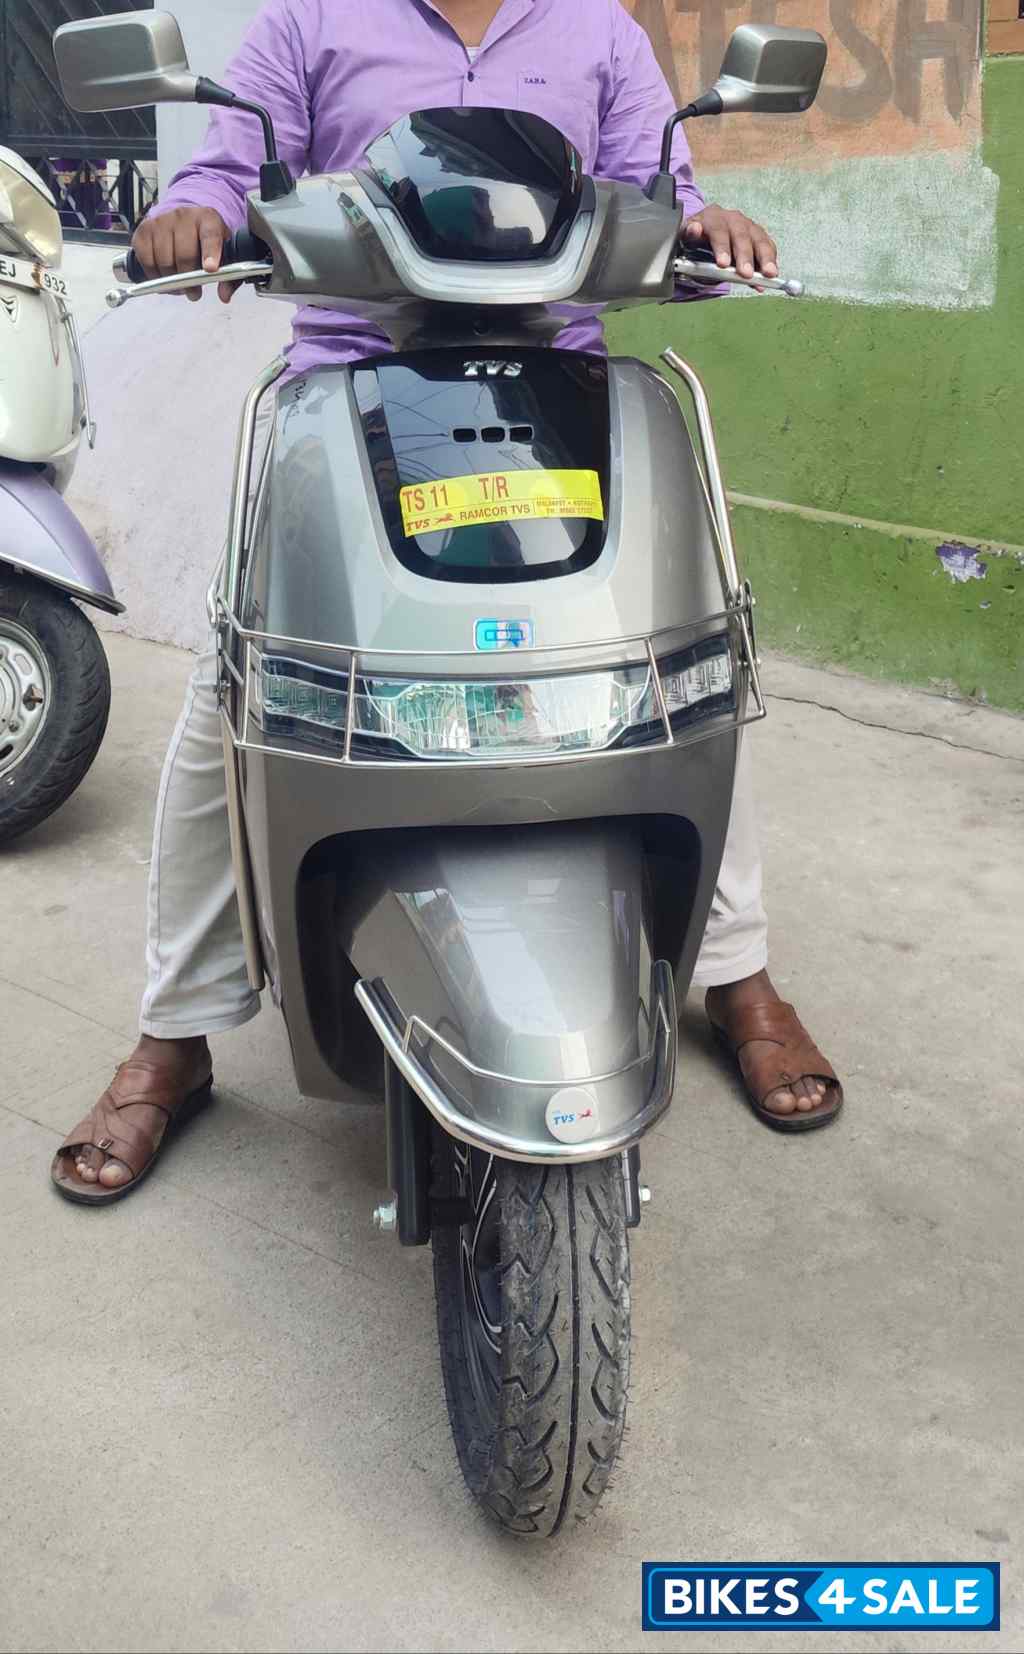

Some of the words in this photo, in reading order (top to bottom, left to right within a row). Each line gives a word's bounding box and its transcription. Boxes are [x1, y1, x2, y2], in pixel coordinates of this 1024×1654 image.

[464, 360, 523, 376] TVS
[402, 488, 425, 513] TS
[430, 484, 448, 508] 11
[478, 475, 510, 504] T/R
[406, 518, 430, 533] TVS
[460, 506, 508, 521] RAMCOR
[511, 503, 531, 515] TVS
[553, 1113, 576, 1125] TVS
